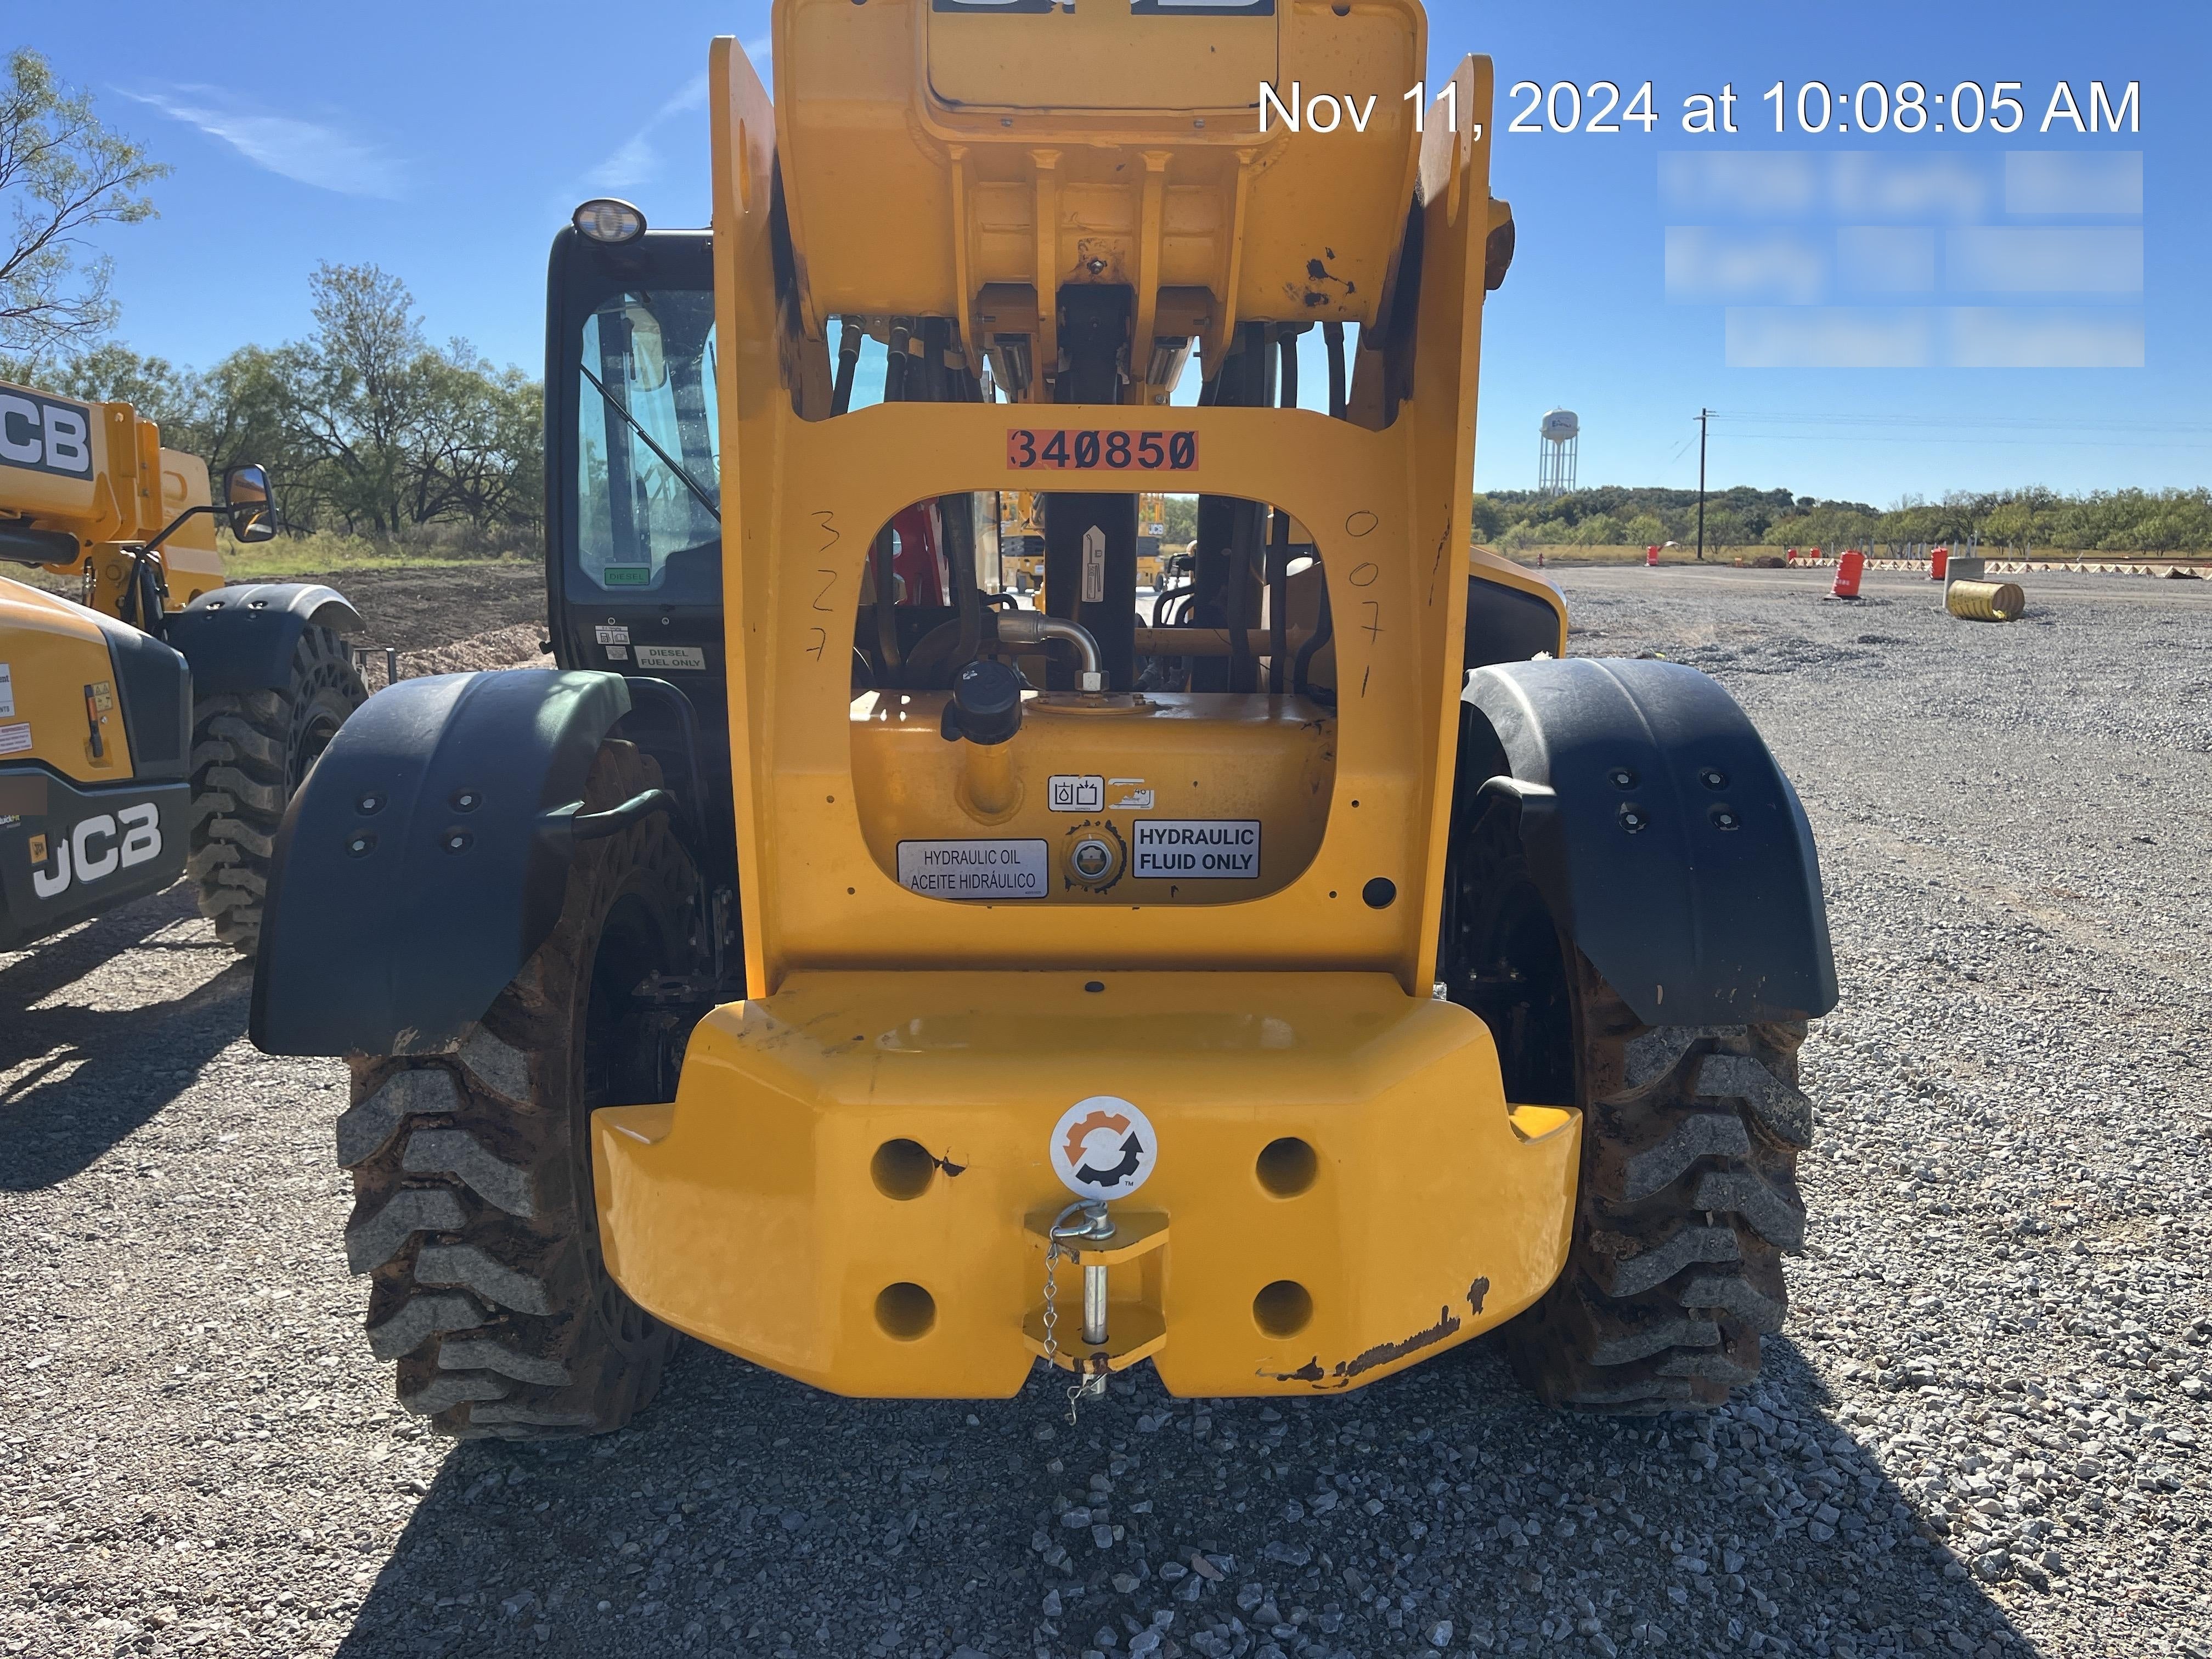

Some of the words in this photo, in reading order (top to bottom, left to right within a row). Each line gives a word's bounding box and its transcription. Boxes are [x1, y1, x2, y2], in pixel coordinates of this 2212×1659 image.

[0, 394, 89, 472] CB
[1011, 430, 1195, 470] 340850
[649, 649, 689, 657] DIESEL
[672, 659, 701, 667] ONLY
[1139, 828, 1255, 845] HYDRAULIC
[33, 802, 163, 898] JCB
[924, 849, 997, 866] HYDRAULIC
[1000, 849, 1021, 865] OIL
[1139, 853, 1197, 870] FLUID
[1201, 853, 1254, 870] ONLY
[910, 873, 956, 890] ACEITE
[959, 870, 1036, 889] HIDRÁULICO
